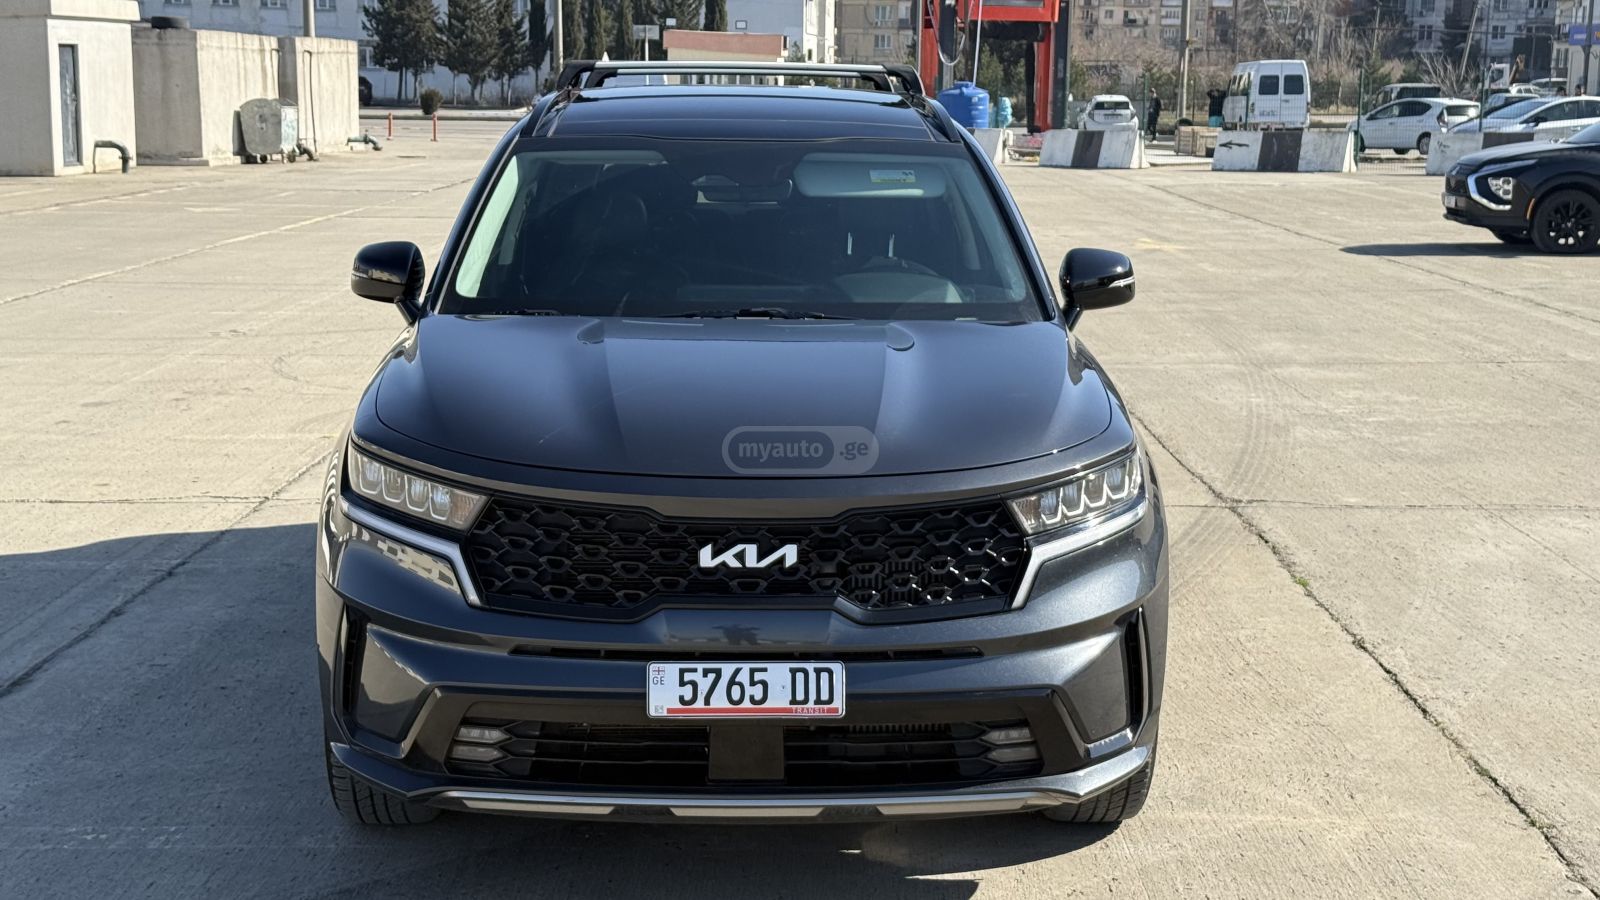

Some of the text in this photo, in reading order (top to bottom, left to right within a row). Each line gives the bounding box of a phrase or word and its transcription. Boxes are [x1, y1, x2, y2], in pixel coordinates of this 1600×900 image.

[699, 543, 798, 568] KIA
[652, 676, 665, 686] GE
[678, 667, 834, 706] 5765 DD
[792, 706, 827, 714] TRANSIT
